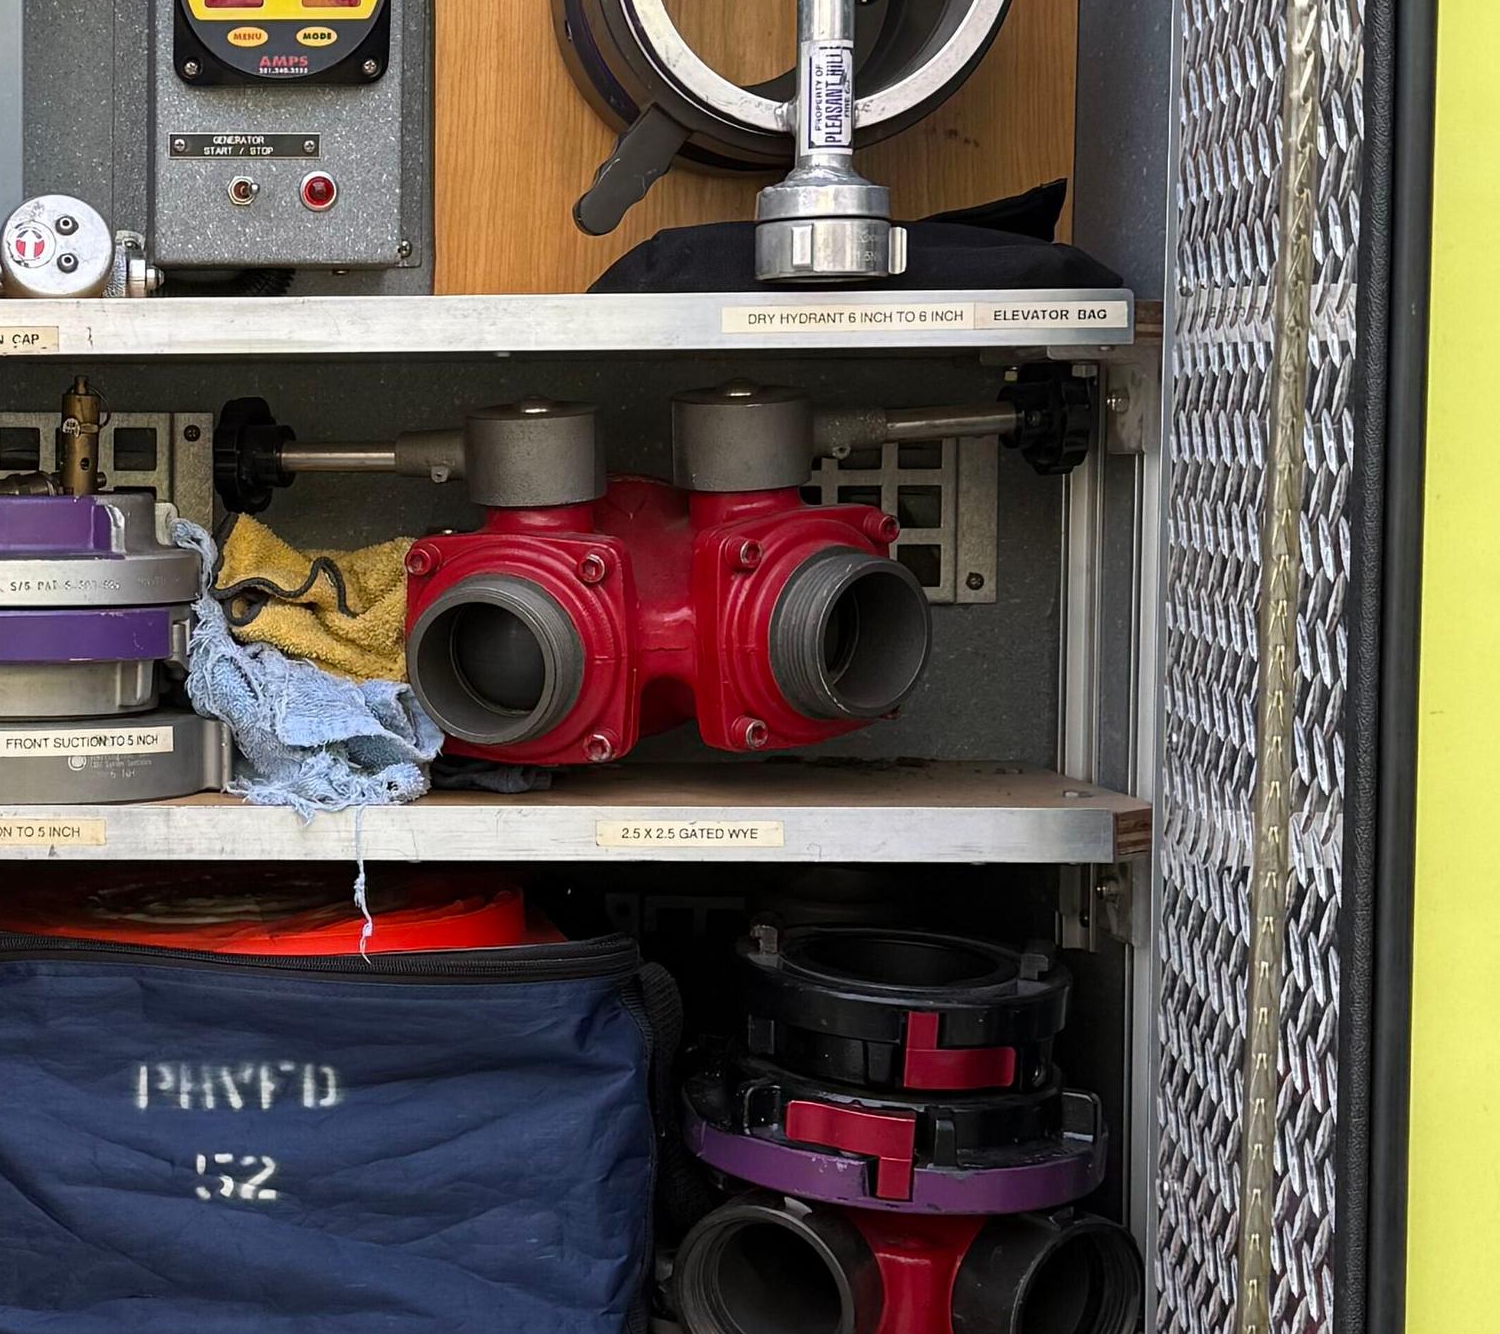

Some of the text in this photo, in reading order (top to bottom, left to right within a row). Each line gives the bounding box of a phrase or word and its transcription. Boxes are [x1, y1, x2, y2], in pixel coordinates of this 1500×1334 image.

[233, 32, 262, 41] MENU
[302, 32, 332, 41] MODE
[259, 54, 309, 67] AMPS
[824, 80, 843, 144] PLEASANT
[212, 135, 265, 146] GENERATOR
[203, 146, 232, 156] START
[249, 146, 274, 156] STOP
[747, 310, 964, 325] DRY HYDRANT 6 INCH TO 6 INCH
[993, 308, 1107, 321] ELEVATOR BAG
[11, 333, 40, 345] CAP
[5, 734, 159, 750] FRONT SUCTION TO 5 INCH
[16, 826, 35, 838] TO
[37, 826, 45, 837] 5
[48, 826, 81, 838] INCH
[621, 827, 759, 839] 2.5 X 2.5 GATED WYE
